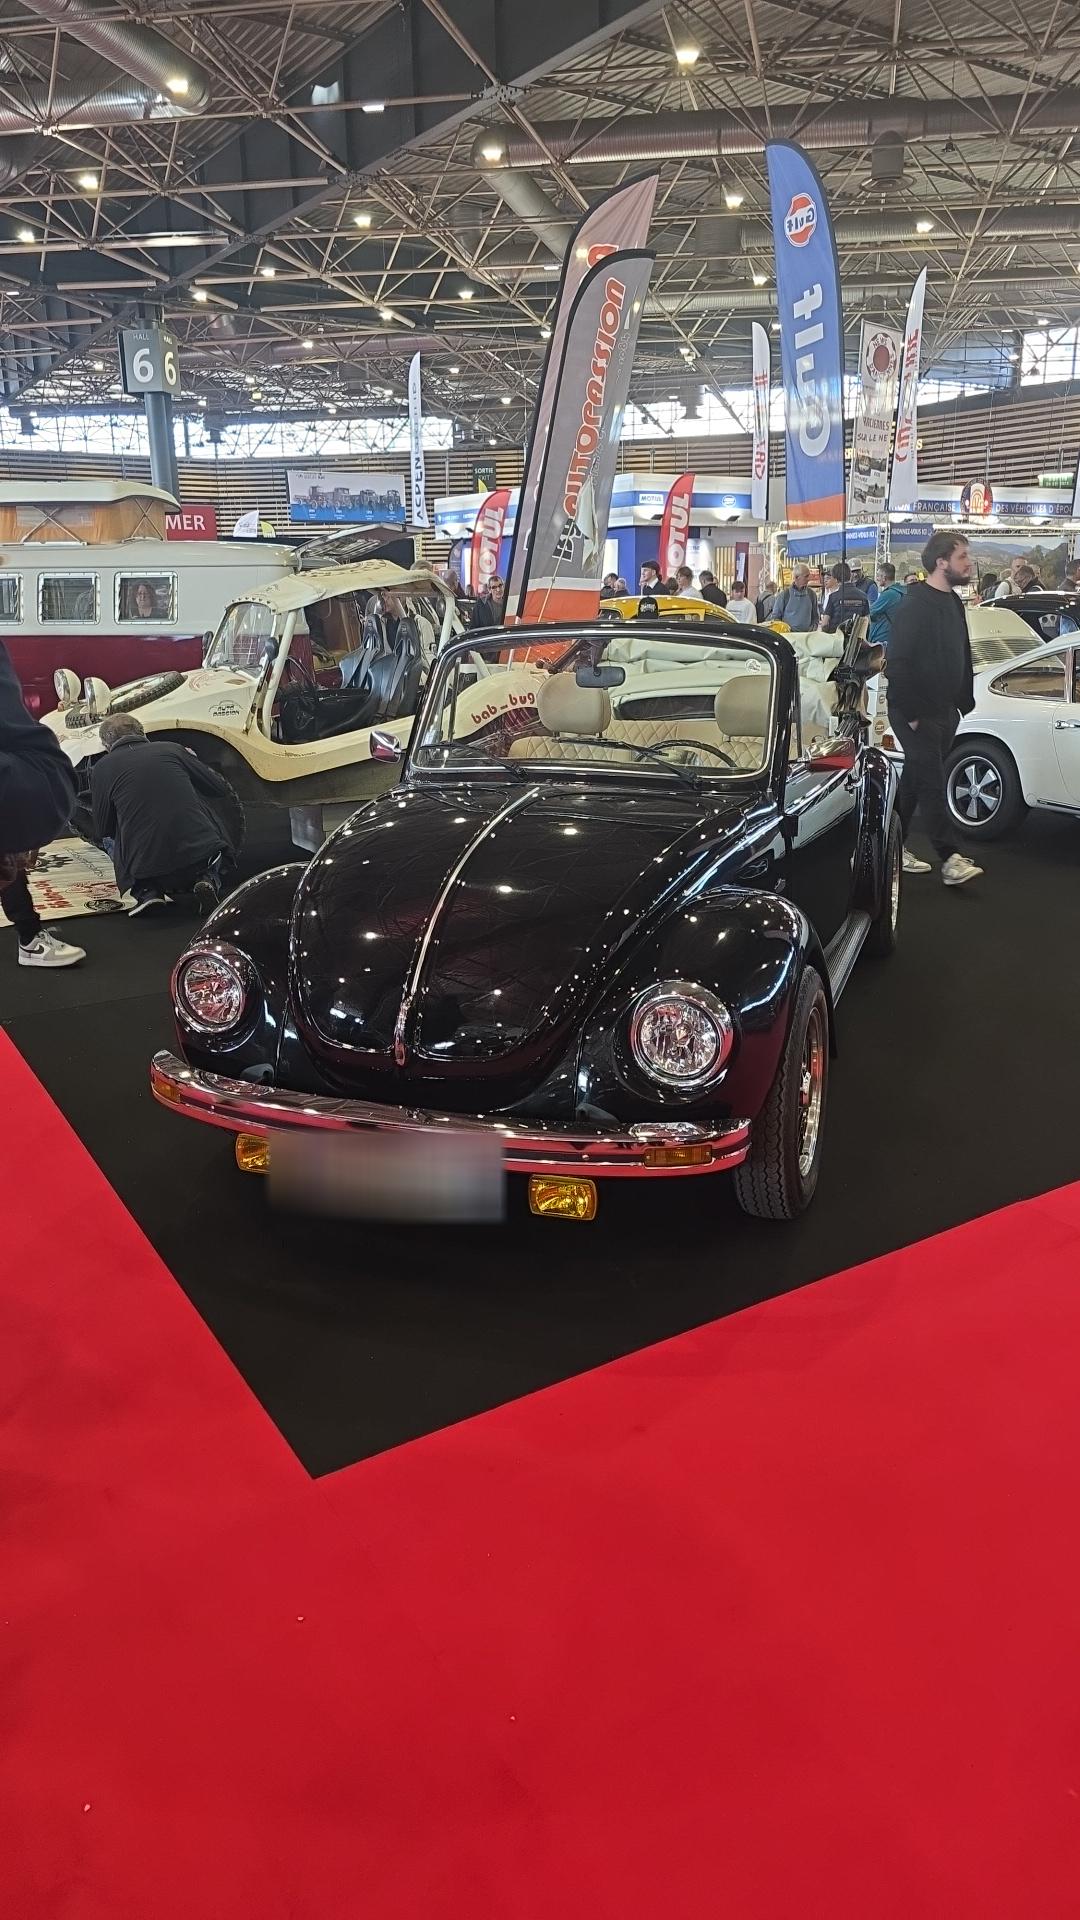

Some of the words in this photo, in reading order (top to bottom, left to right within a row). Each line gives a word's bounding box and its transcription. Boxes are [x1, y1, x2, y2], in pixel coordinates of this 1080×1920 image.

[133, 348, 154, 383] 6
[164, 351, 177, 386] 6
[912, 501, 956, 513] FRANÇAISE
[995, 504, 1009, 513] DES
[1011, 503, 1047, 513] VÉHICULES
